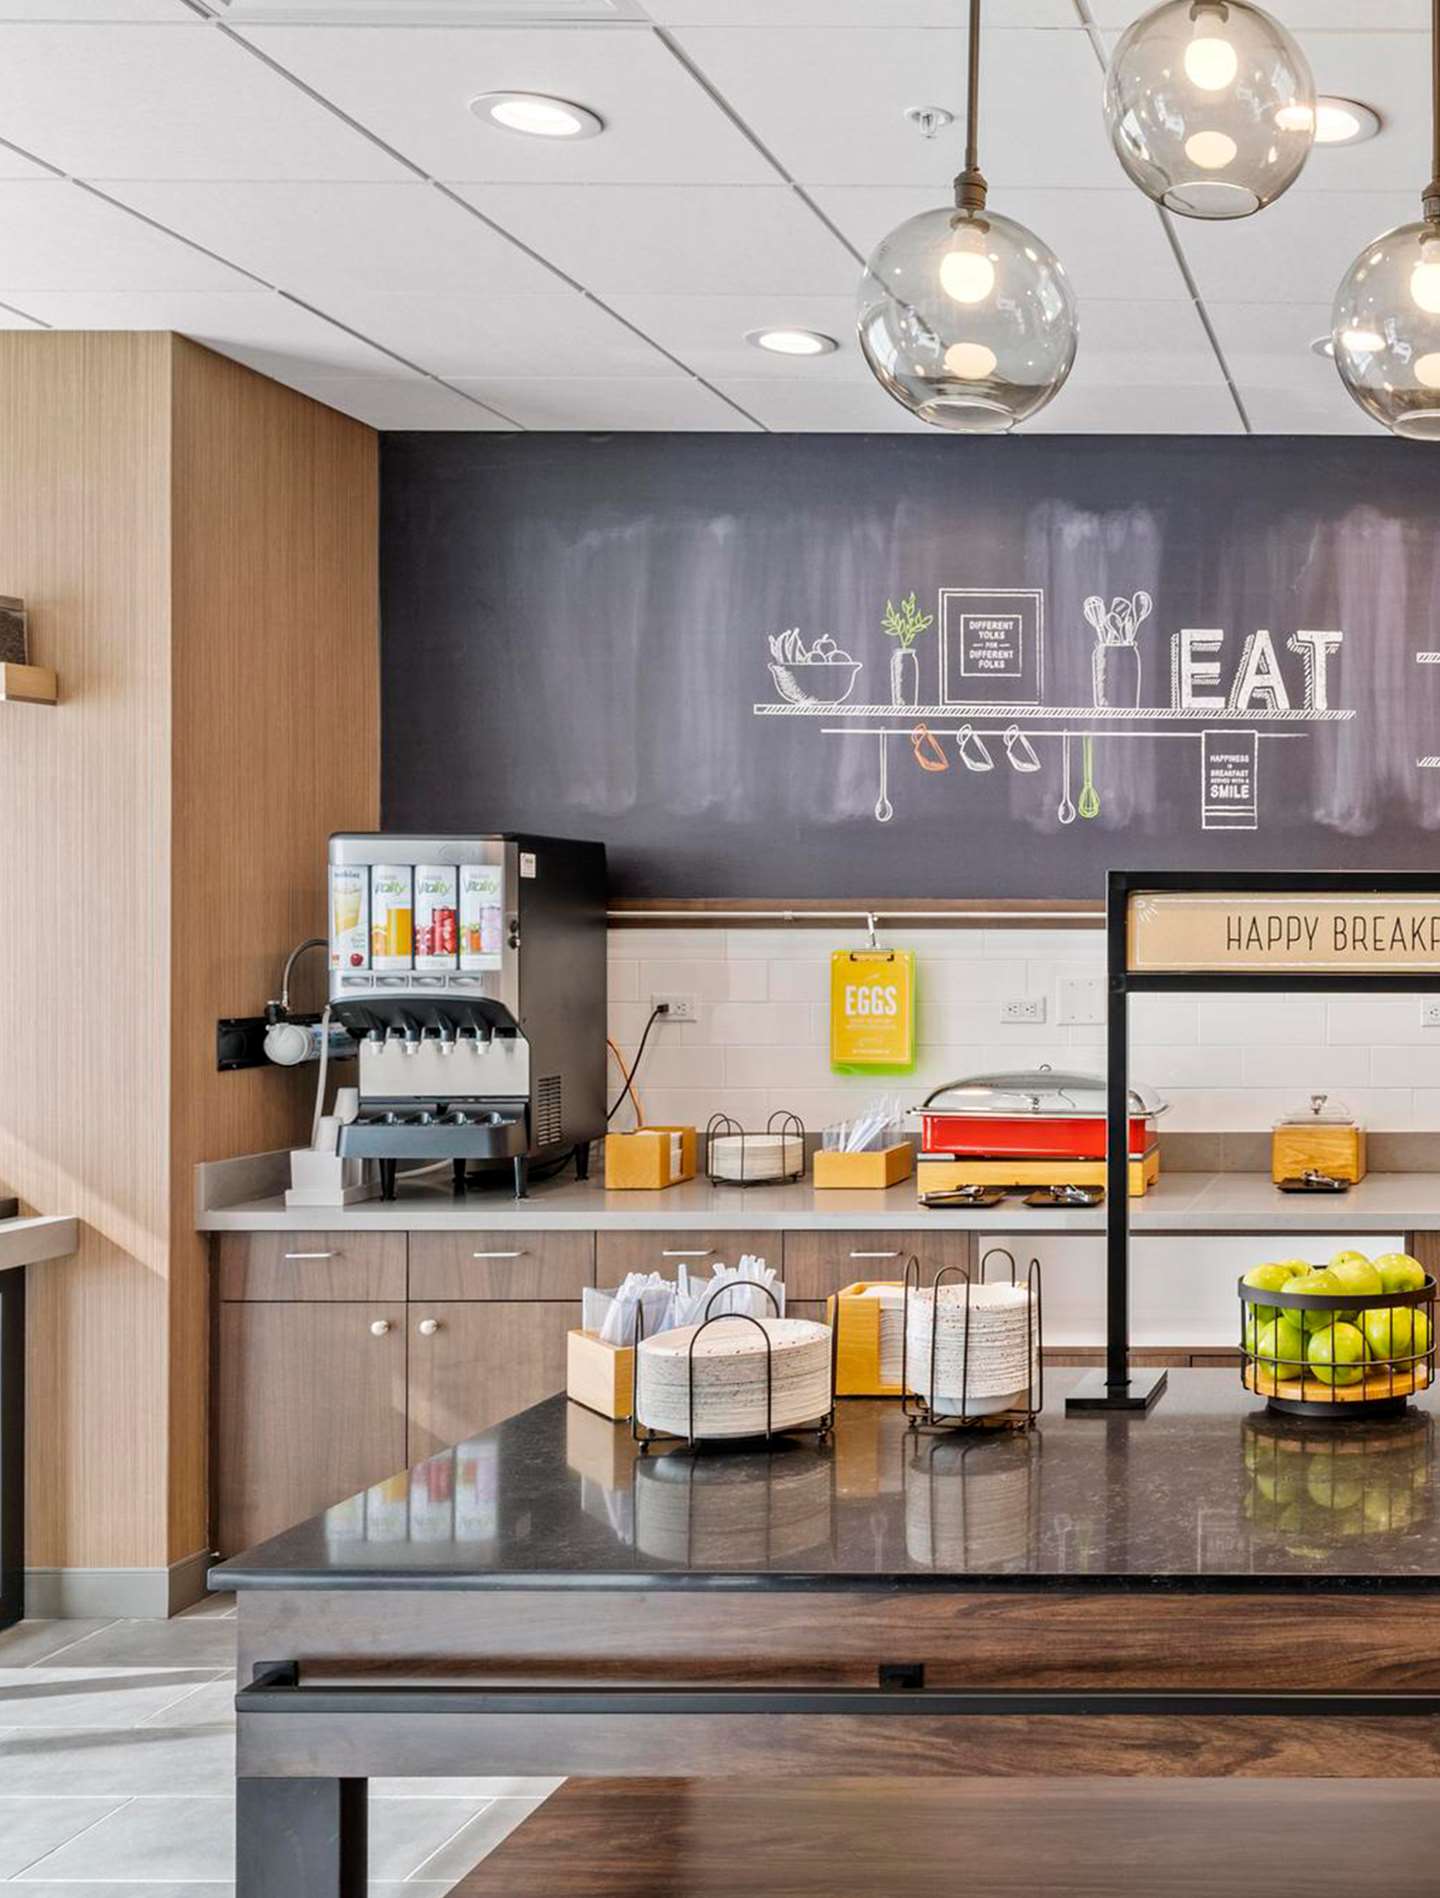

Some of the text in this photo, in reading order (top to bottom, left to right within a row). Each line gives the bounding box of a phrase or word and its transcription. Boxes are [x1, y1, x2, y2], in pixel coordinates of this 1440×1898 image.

[969, 620, 1014, 630] DIFFERENT
[978, 631, 1005, 640] YOLKS
[969, 649, 1014, 659] DIFFERENT
[978, 659, 1005, 669] FOLKS
[1171, 628, 1344, 712] EAT
[1210, 754, 1249, 763] HAPPINESS
[1210, 769, 1249, 777] BREAKFAST
[1210, 784, 1249, 799] SMILE
[1226, 915, 1318, 951] HAPPY
[845, 984, 897, 1016] EGGS
